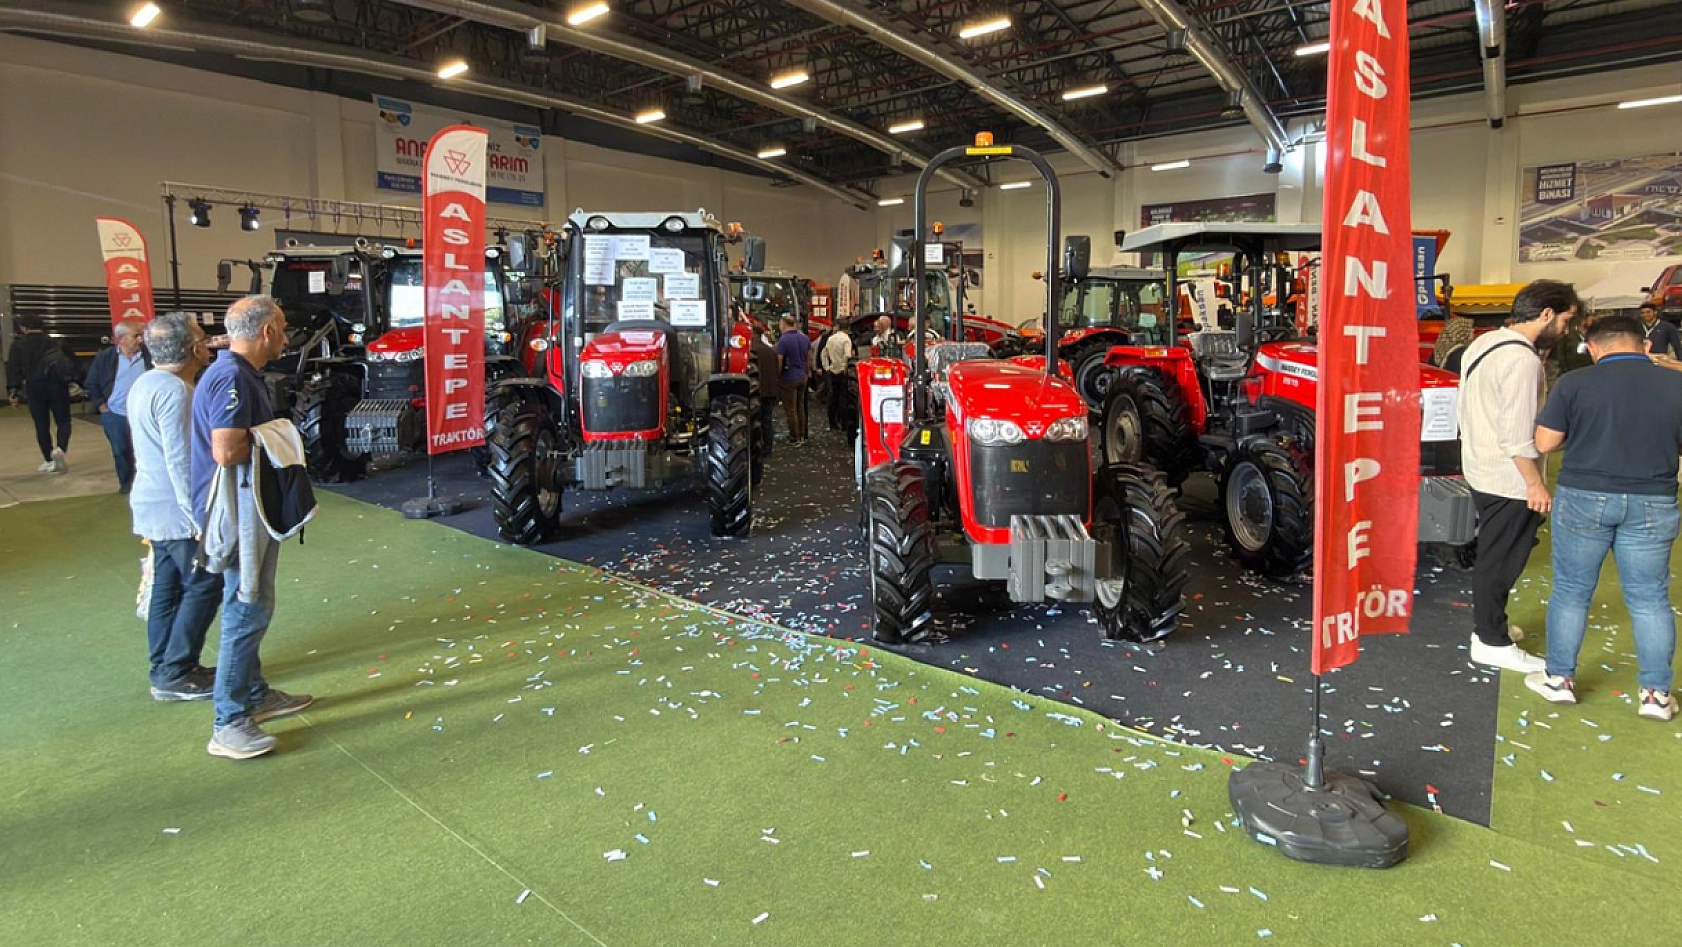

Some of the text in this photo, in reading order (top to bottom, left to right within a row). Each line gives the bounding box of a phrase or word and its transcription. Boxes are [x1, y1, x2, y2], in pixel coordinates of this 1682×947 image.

[488, 153, 529, 173] ARIM
[439, 202, 472, 420] ASLANTEPE
[1342, 0, 1391, 571] ASLANTEPE
[432, 427, 485, 447] TRAKTÖR
[1322, 584, 1408, 649] TRTÖR
